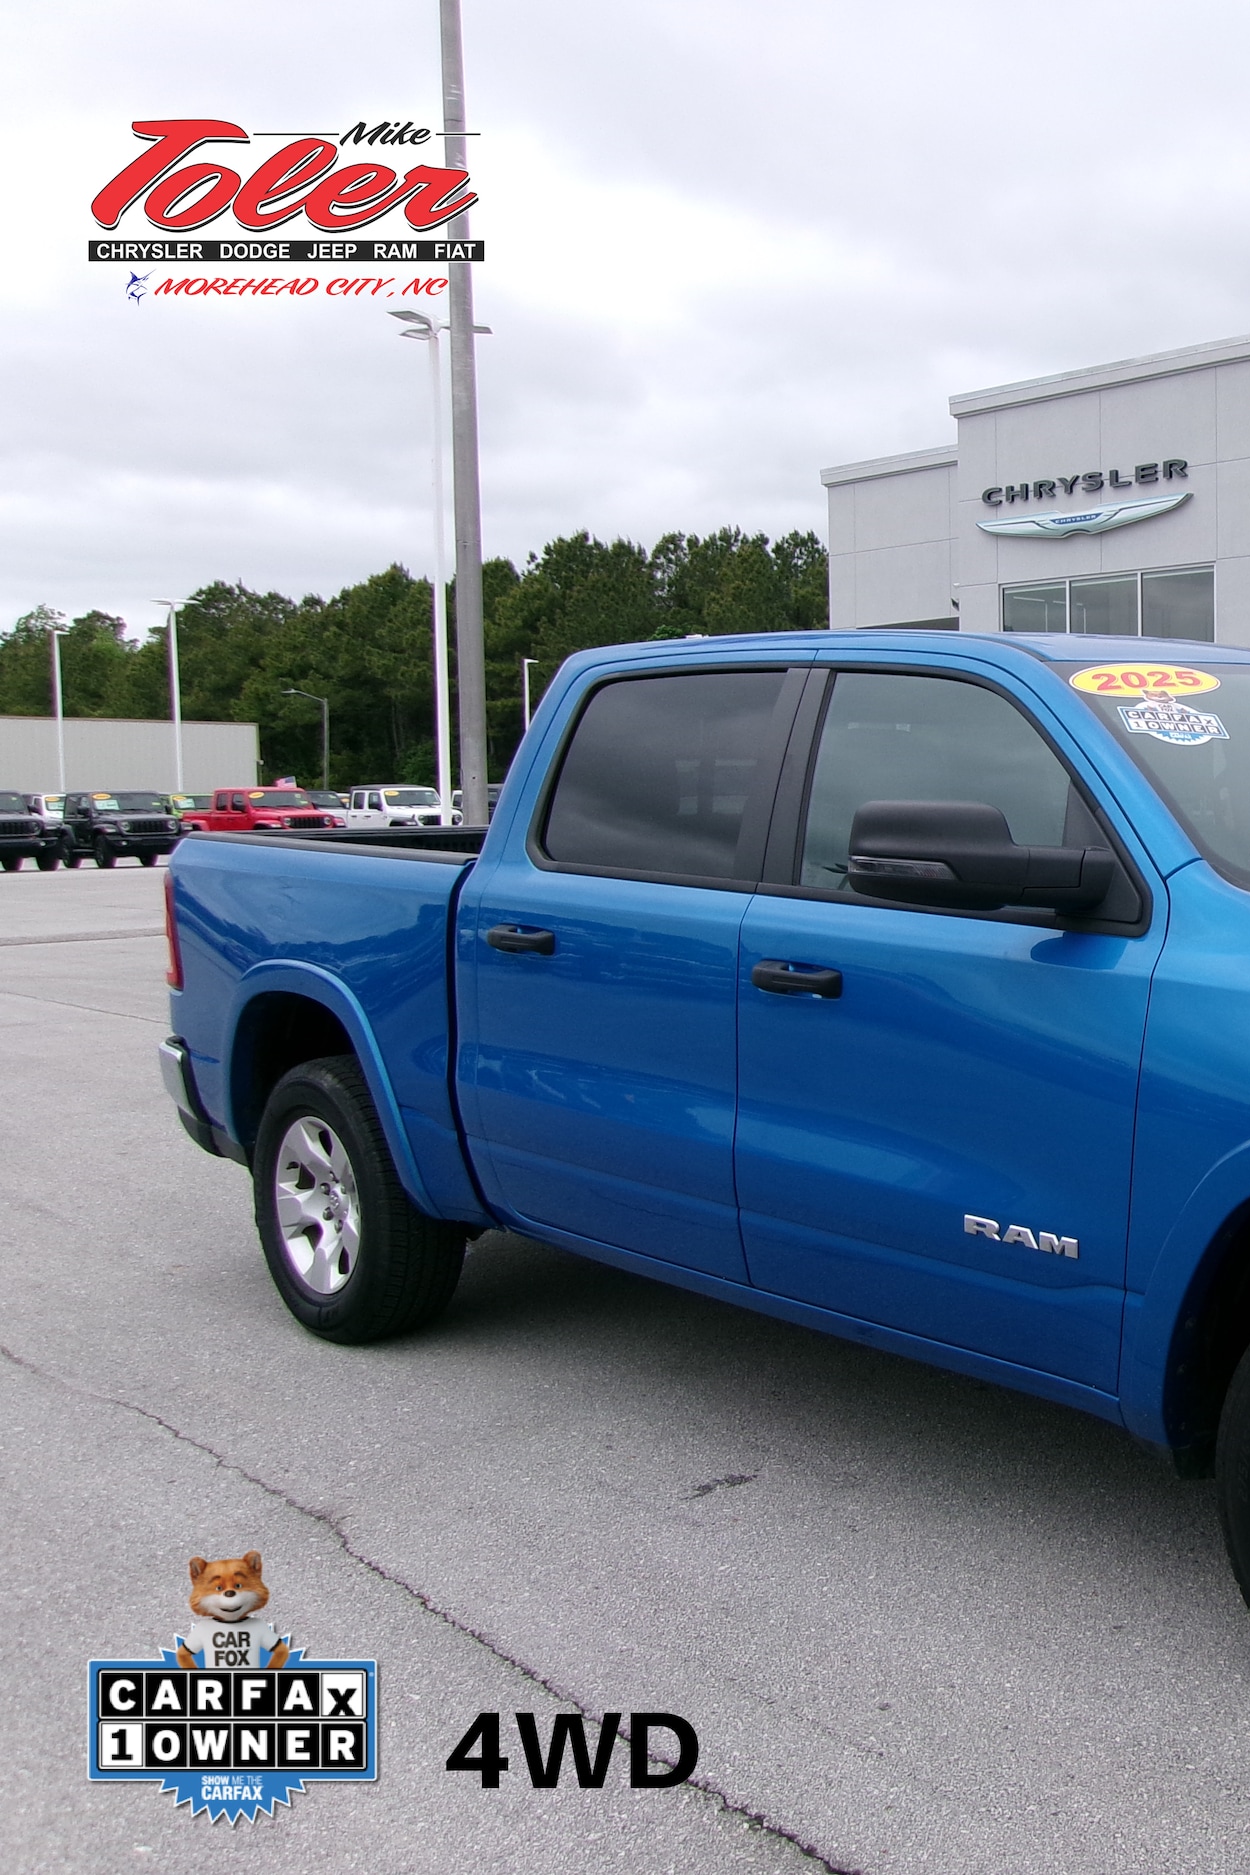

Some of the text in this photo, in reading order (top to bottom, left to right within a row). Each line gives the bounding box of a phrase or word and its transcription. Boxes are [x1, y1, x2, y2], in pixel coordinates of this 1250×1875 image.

[981, 459, 1189, 506] CHRYSLER
[1055, 514, 1097, 524] CHRYSLER
[1091, 670, 1201, 691] 2025
[1128, 711, 1215, 726] CARFAX
[1148, 722, 1220, 735] OWNER
[964, 1214, 1079, 1259] RAM
